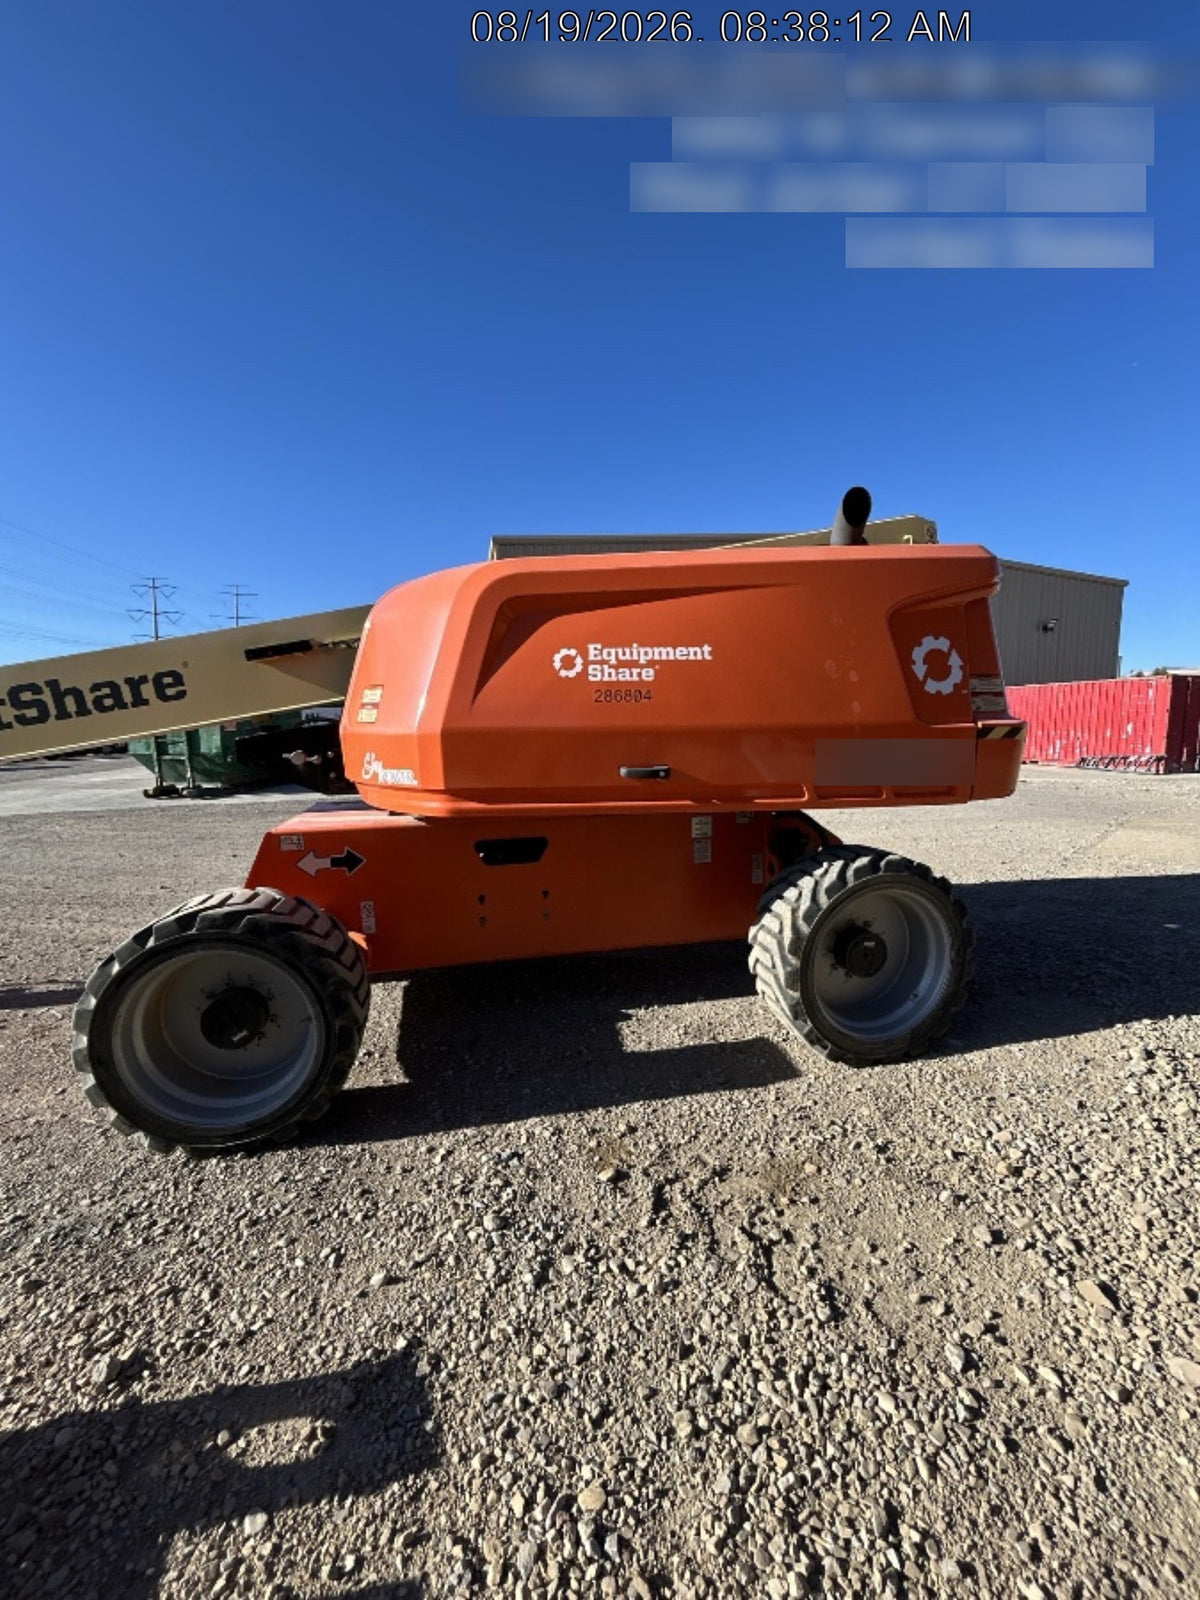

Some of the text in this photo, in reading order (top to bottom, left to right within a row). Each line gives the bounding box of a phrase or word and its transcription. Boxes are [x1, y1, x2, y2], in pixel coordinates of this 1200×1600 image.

[587, 643, 713, 664] Equipment
[587, 664, 655, 682] Share
[594, 689, 652, 703] 286804
